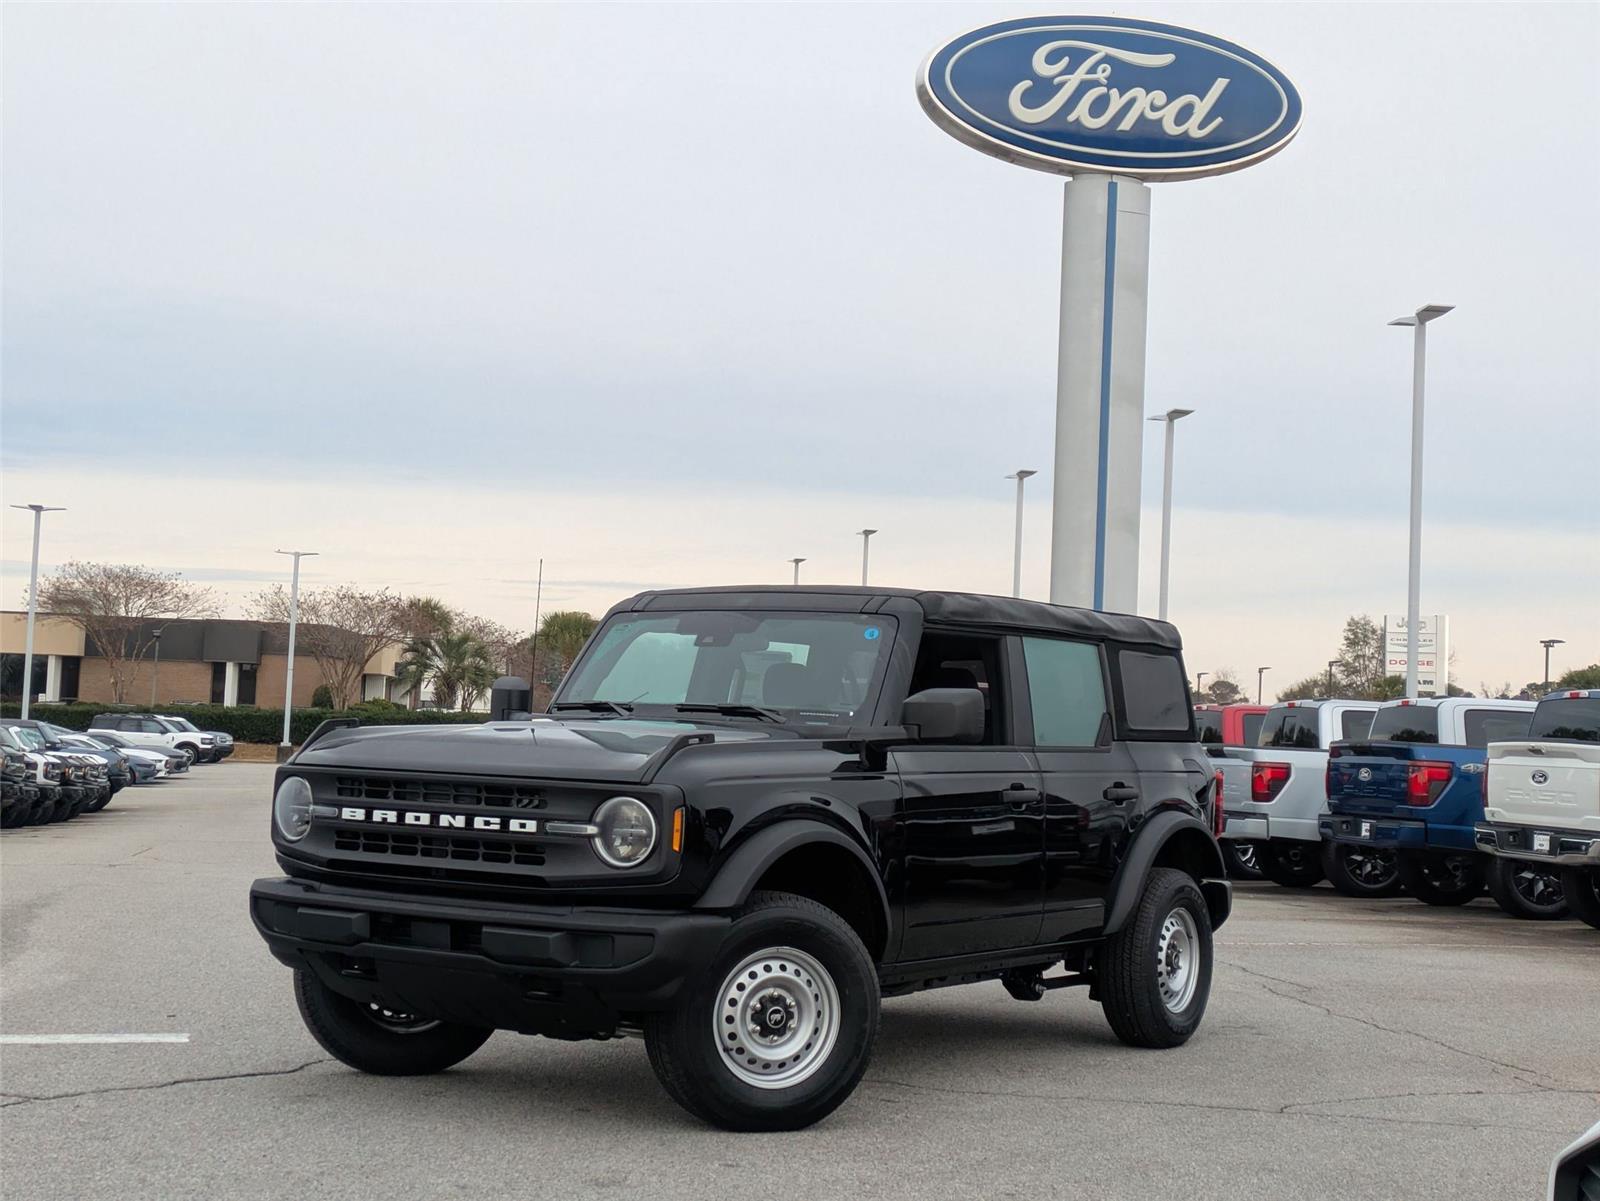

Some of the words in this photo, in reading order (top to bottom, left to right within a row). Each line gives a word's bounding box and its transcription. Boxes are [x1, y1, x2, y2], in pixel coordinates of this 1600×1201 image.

[1008, 40, 1231, 139] Ford
[1396, 617, 1427, 631] Jp
[341, 807, 537, 833] BRONCO
